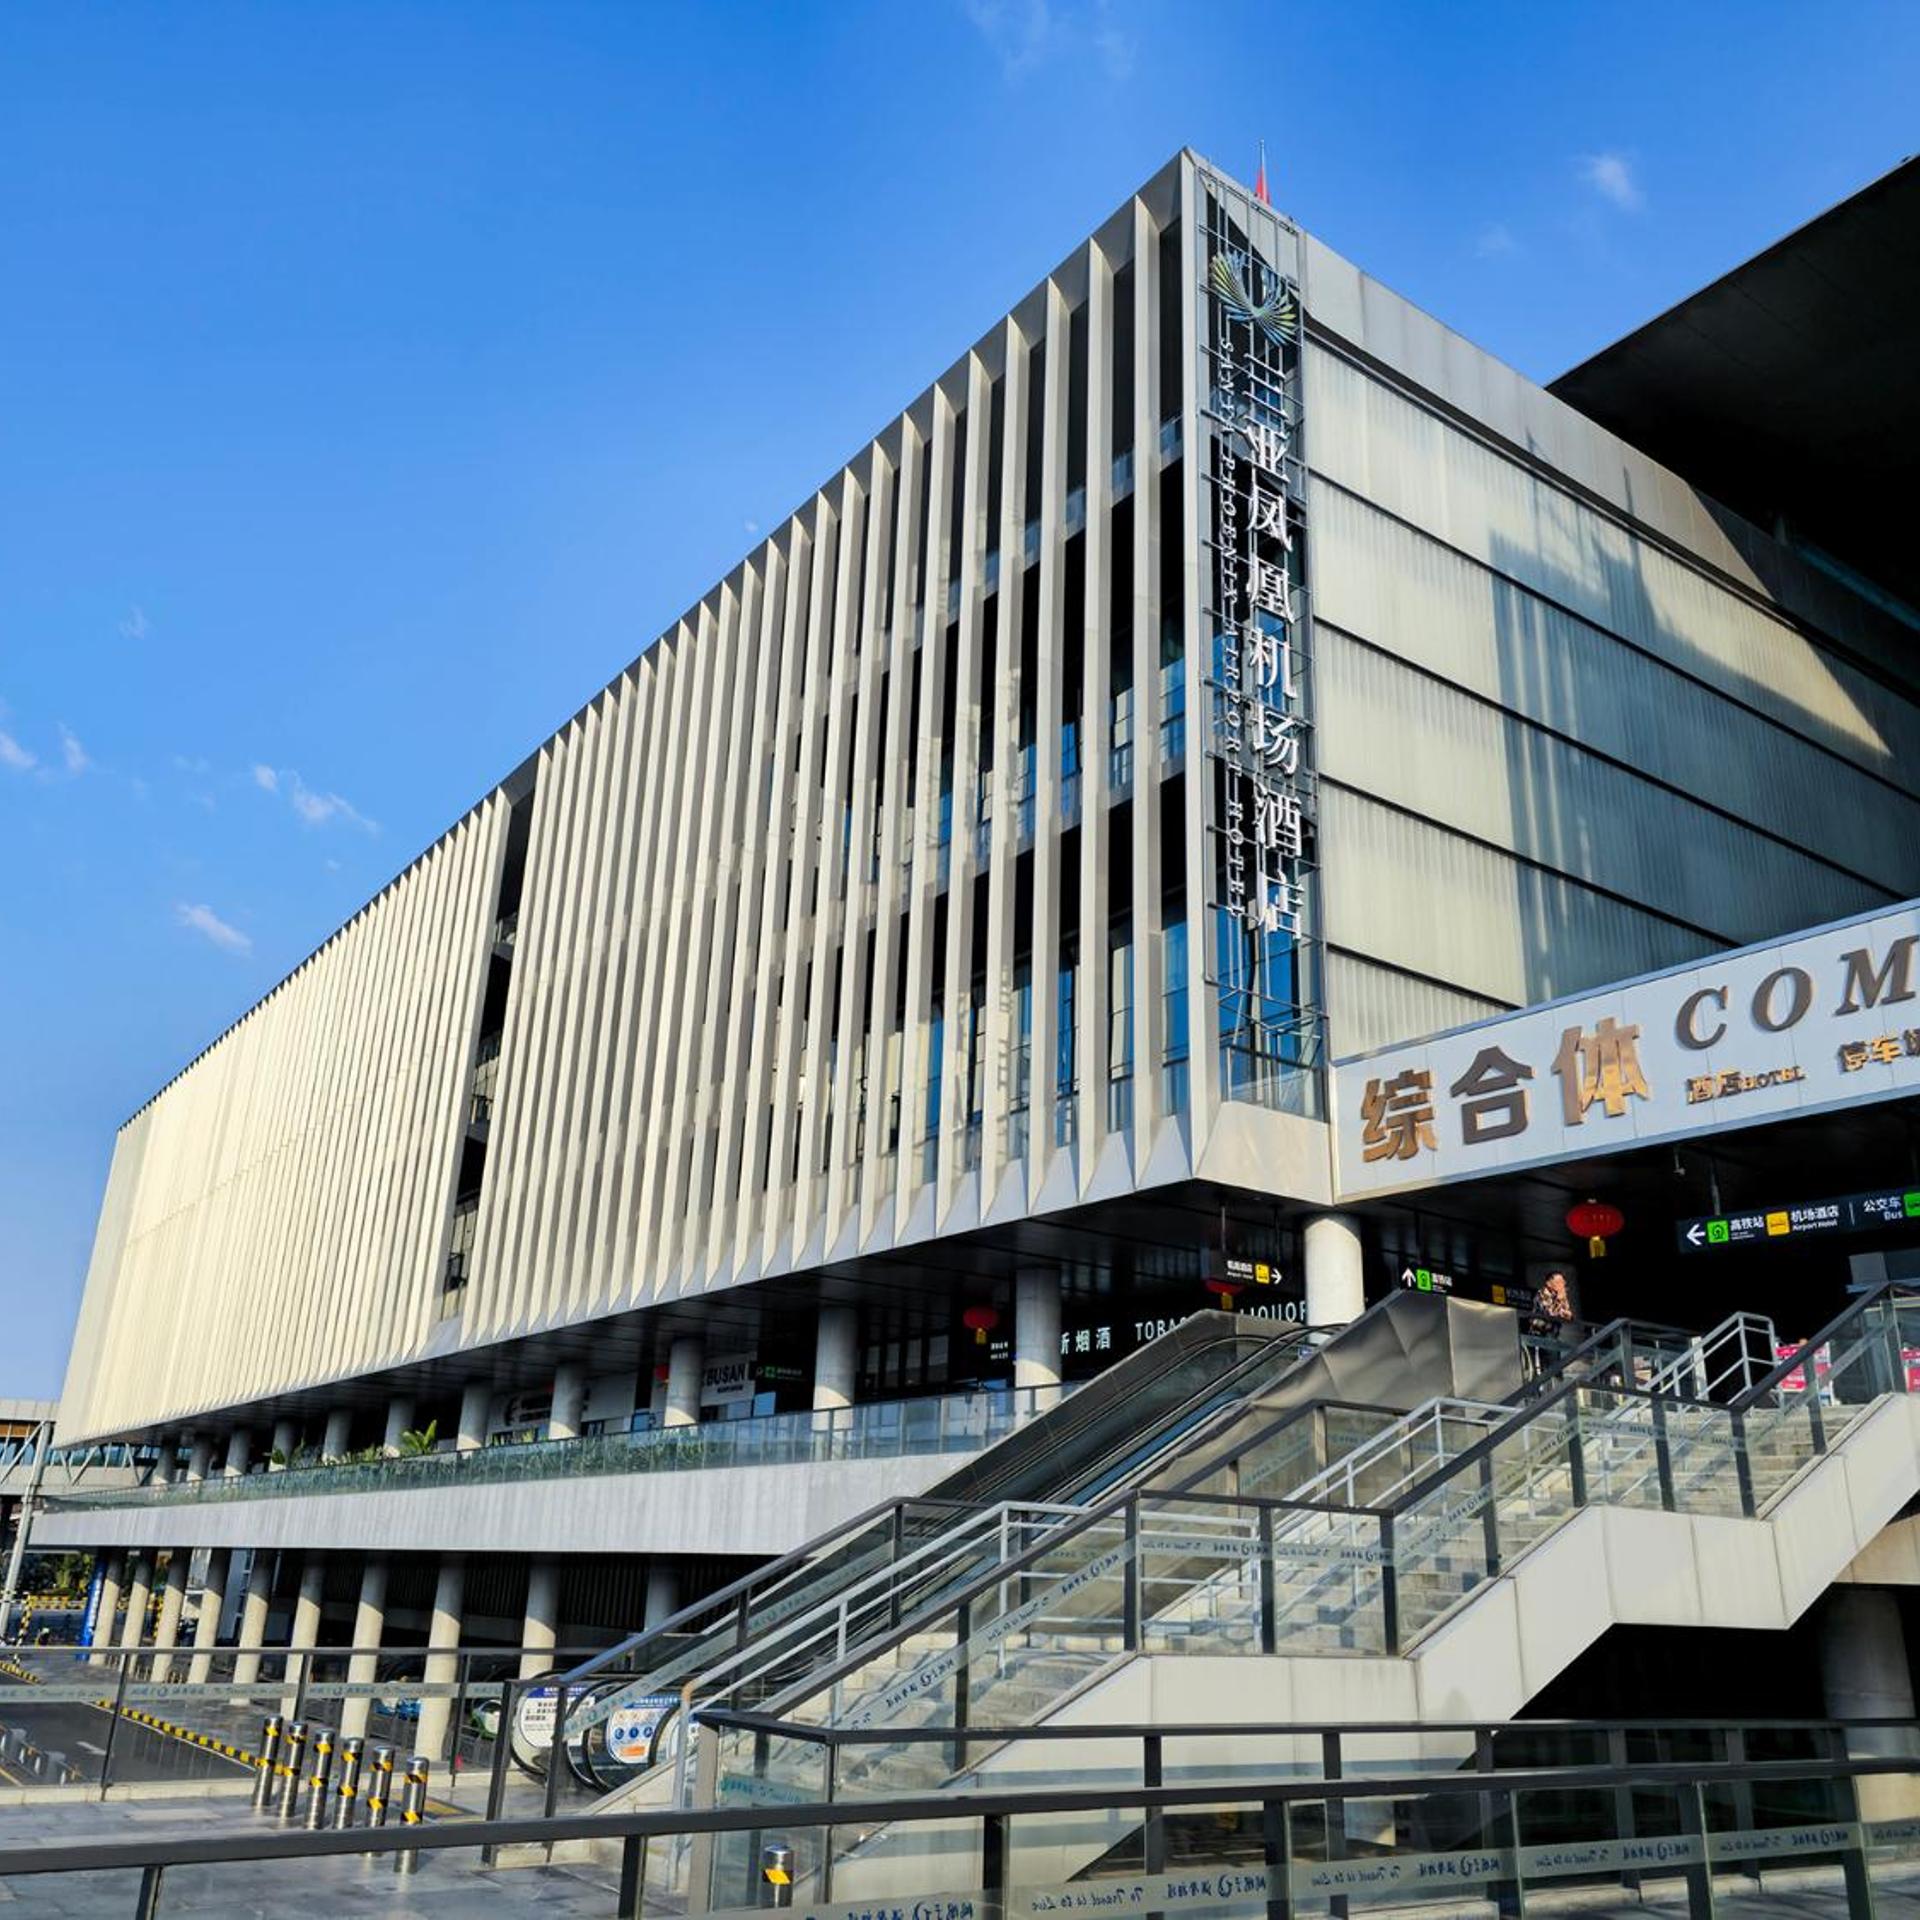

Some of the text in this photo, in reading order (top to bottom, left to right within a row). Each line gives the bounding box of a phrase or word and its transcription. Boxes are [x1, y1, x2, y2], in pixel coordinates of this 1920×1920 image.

[1220, 337, 1246, 917] SANYA PHOENIX AIRPORT HOTEL
[1242, 352, 1305, 939] 三亚凤凰机场酒店
[1361, 1016, 1650, 1163] 综合体
[1742, 1066, 1806, 1091] HOTEL
[1863, 1196, 1901, 1213] 公交车
[1729, 1205, 1839, 1231] 高铁站 机场酒店
[1792, 1221, 1818, 1233] Airport
